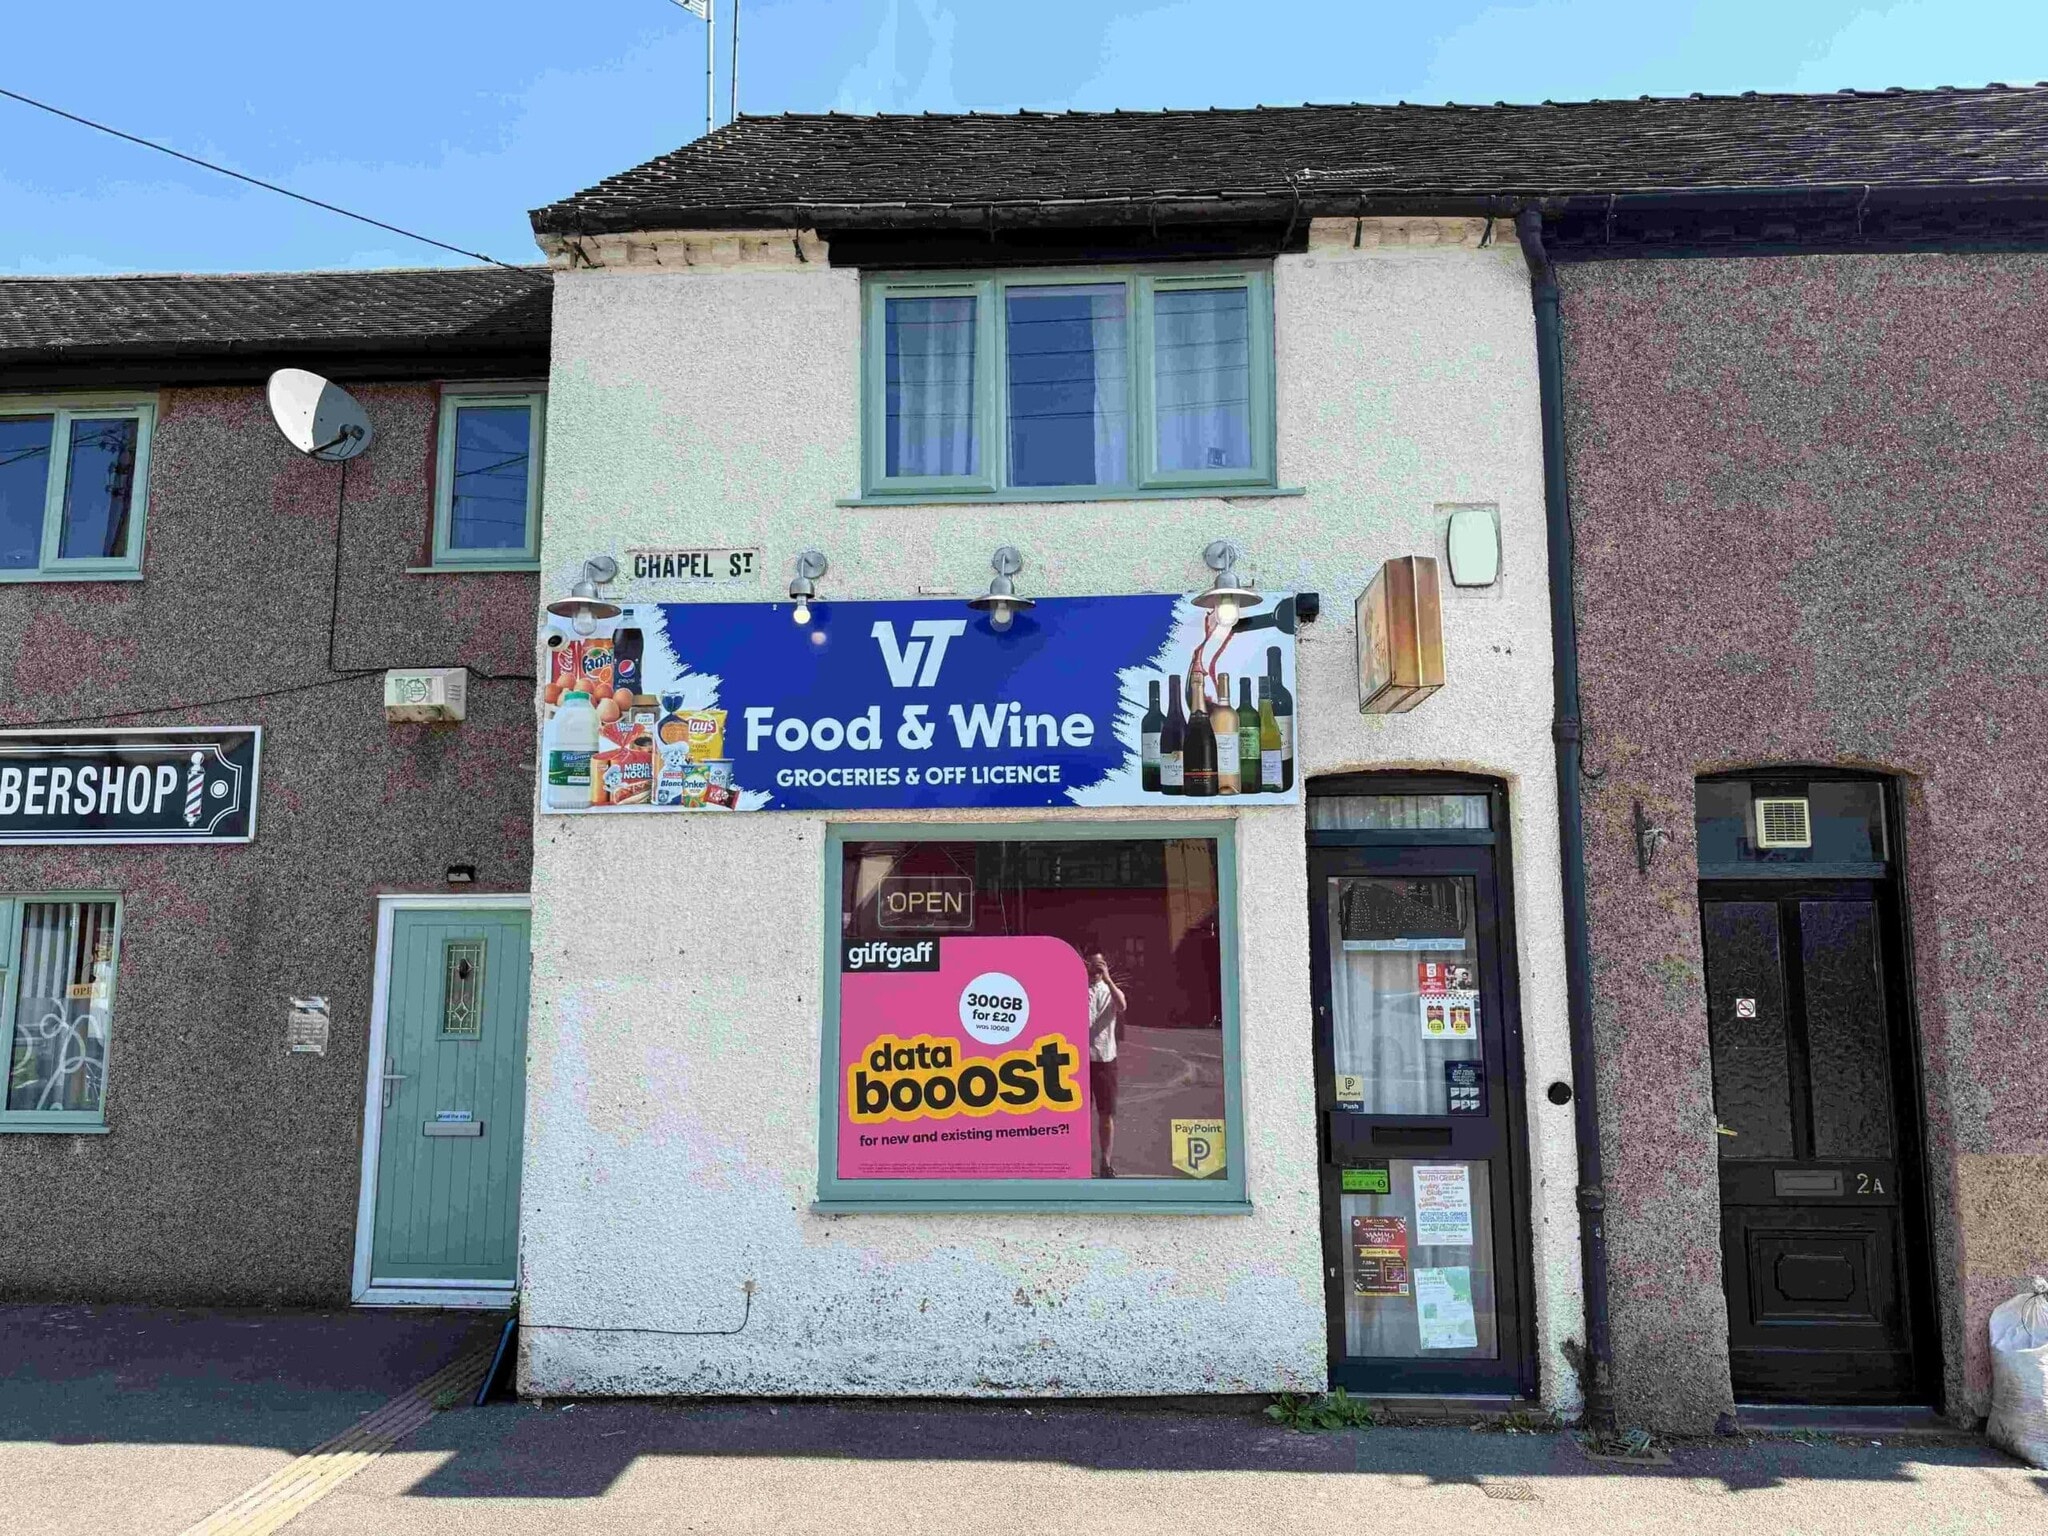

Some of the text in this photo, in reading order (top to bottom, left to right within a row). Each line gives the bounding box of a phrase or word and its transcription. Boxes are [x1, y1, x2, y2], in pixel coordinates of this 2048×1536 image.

[634, 553, 714, 578] CHAPEL
[743, 701, 1095, 751] Food & Wine
[624, 763, 650, 772] MEDIA
[776, 765, 1061, 787] GROCERIES & OFF LICENCE
[0, 765, 178, 815] BERSHOP
[889, 892, 962, 913] OPEN
[848, 941, 933, 968] giffgaff
[967, 993, 1023, 1011] 300GB
[972, 1009, 1016, 1023] for £20
[991, 1024, 1010, 1032] 100GB
[870, 1042, 953, 1072] data
[856, 1042, 1074, 1114] booost
[860, 1123, 1070, 1146] for new and existing members?!
[1175, 1124, 1222, 1135] PayPoint
[1857, 1173, 1885, 1194] 2A
